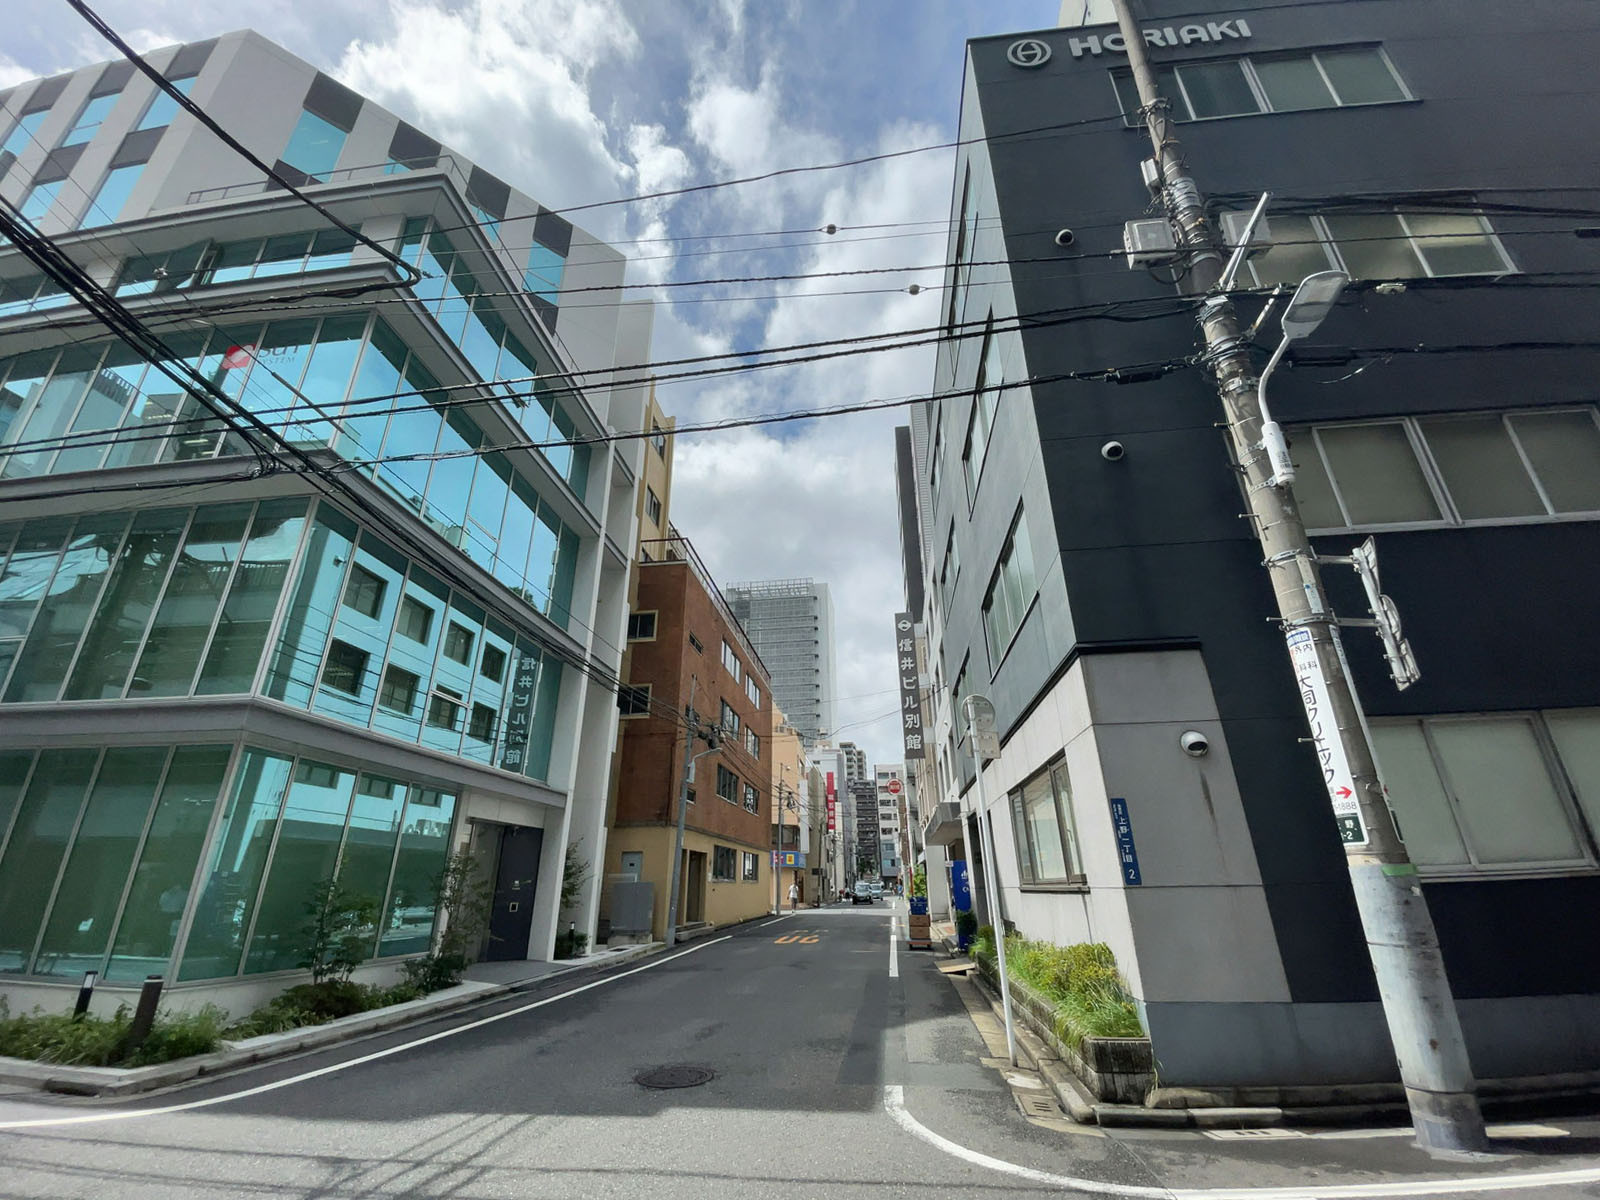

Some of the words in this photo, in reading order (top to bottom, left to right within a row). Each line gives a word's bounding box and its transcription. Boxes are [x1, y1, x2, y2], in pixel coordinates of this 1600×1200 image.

[1068, 19, 1251, 58] HORIAKI
[899, 638, 922, 750] 信井ビル別館
[1128, 868, 1136, 880] 2
